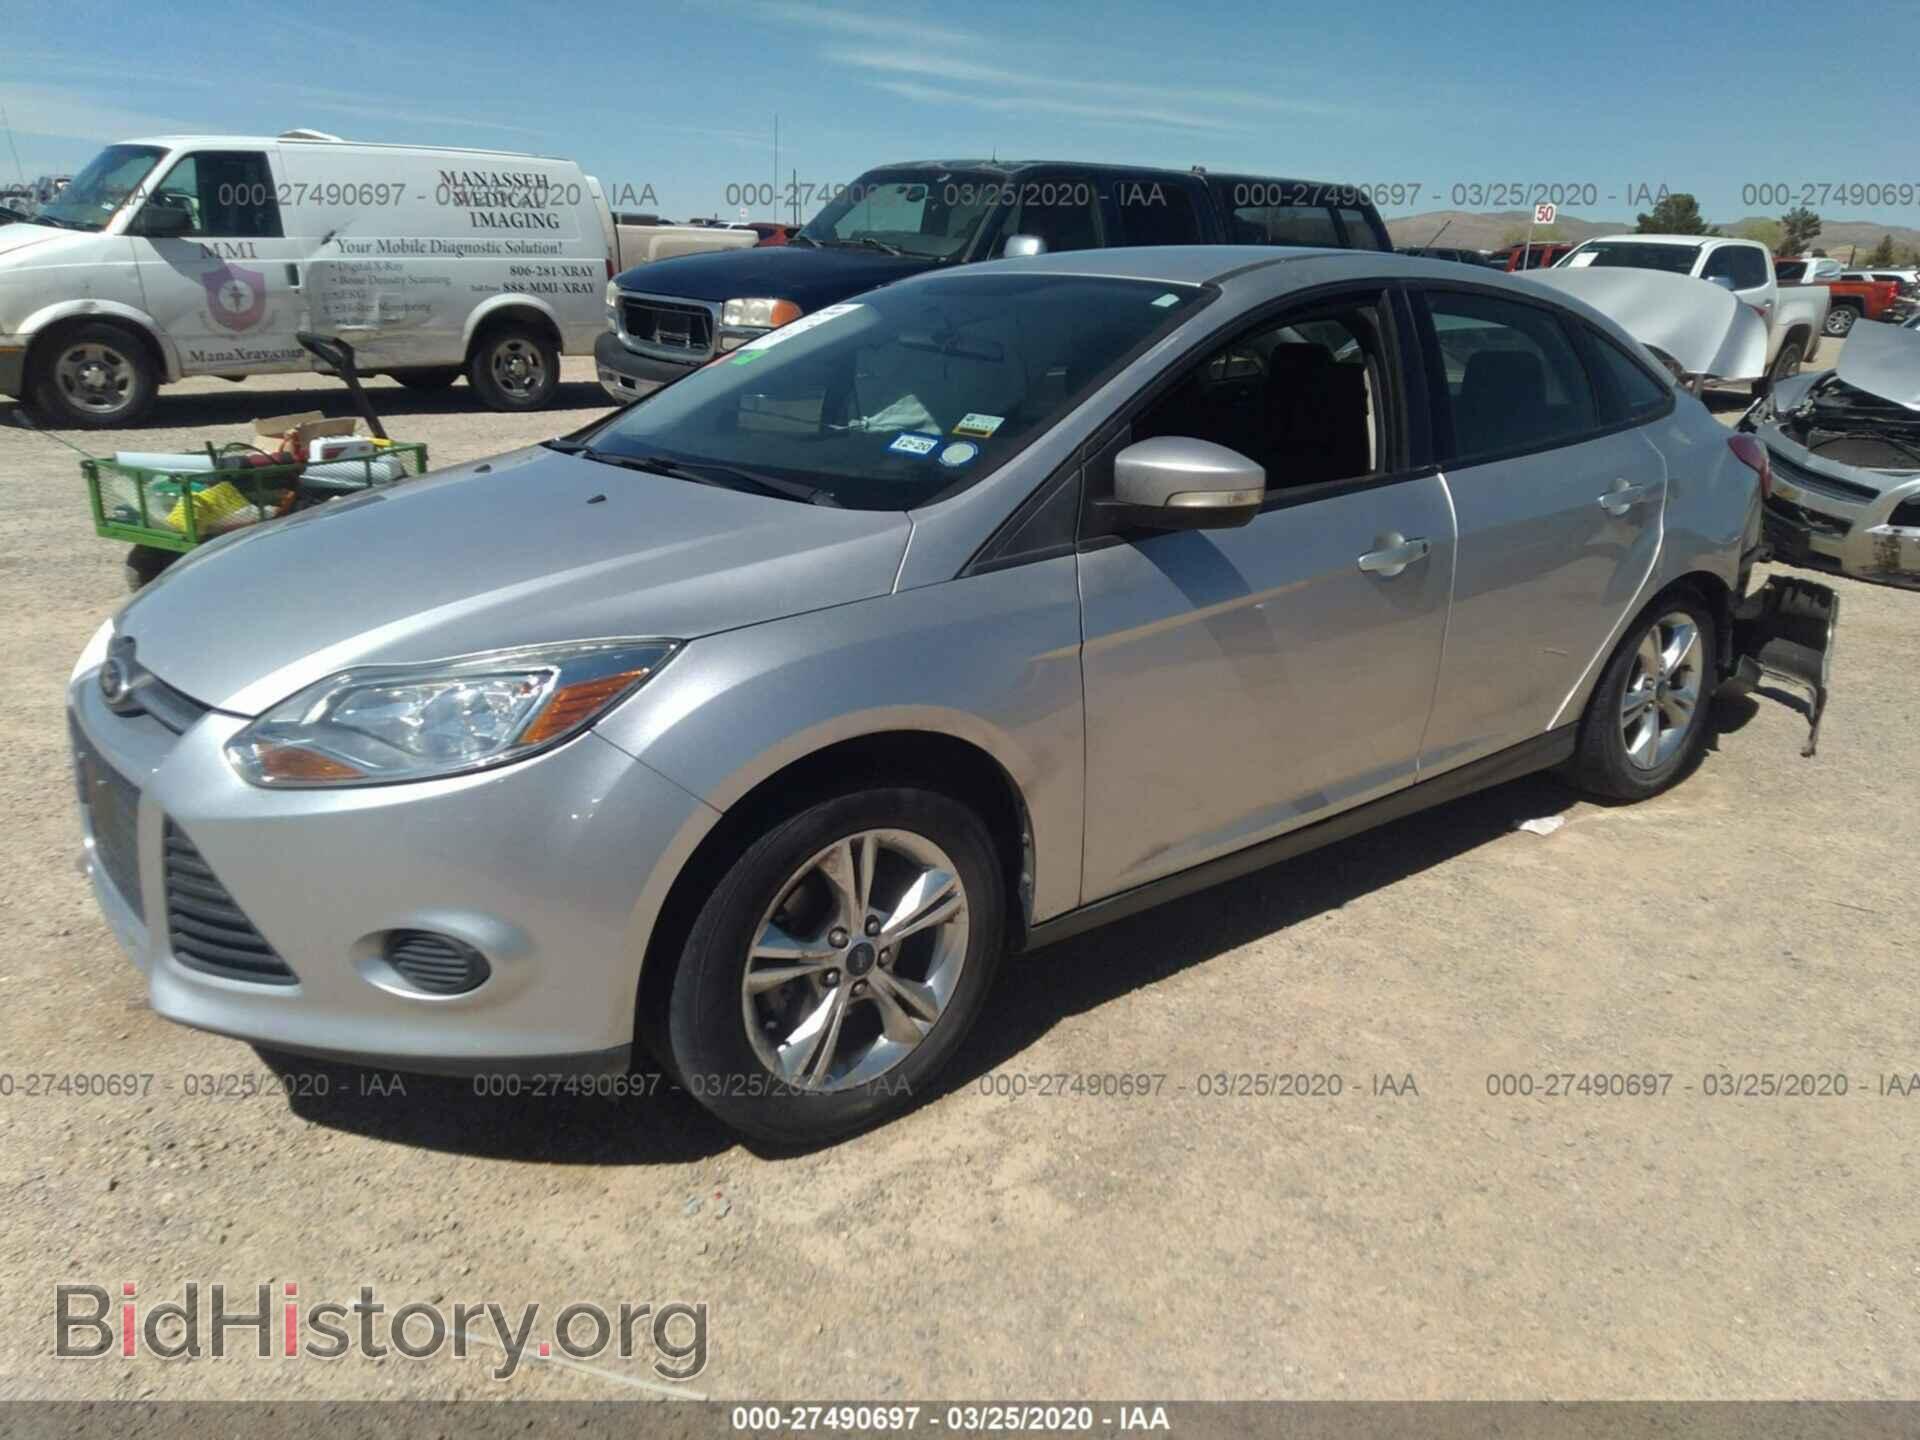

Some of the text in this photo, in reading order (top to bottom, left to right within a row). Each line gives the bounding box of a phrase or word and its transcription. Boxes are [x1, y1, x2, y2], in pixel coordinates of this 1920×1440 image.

[439, 170, 550, 190] MANASSEH
[454, 189, 547, 209] MEDICAL
[470, 211, 560, 229] IMAGING
[1536, 205, 1554, 222] 50
[199, 241, 258, 259] MMI
[336, 238, 563, 258] Your Mobile Diagnostic Solution!
[509, 265, 596, 277] 806-281-XRAY
